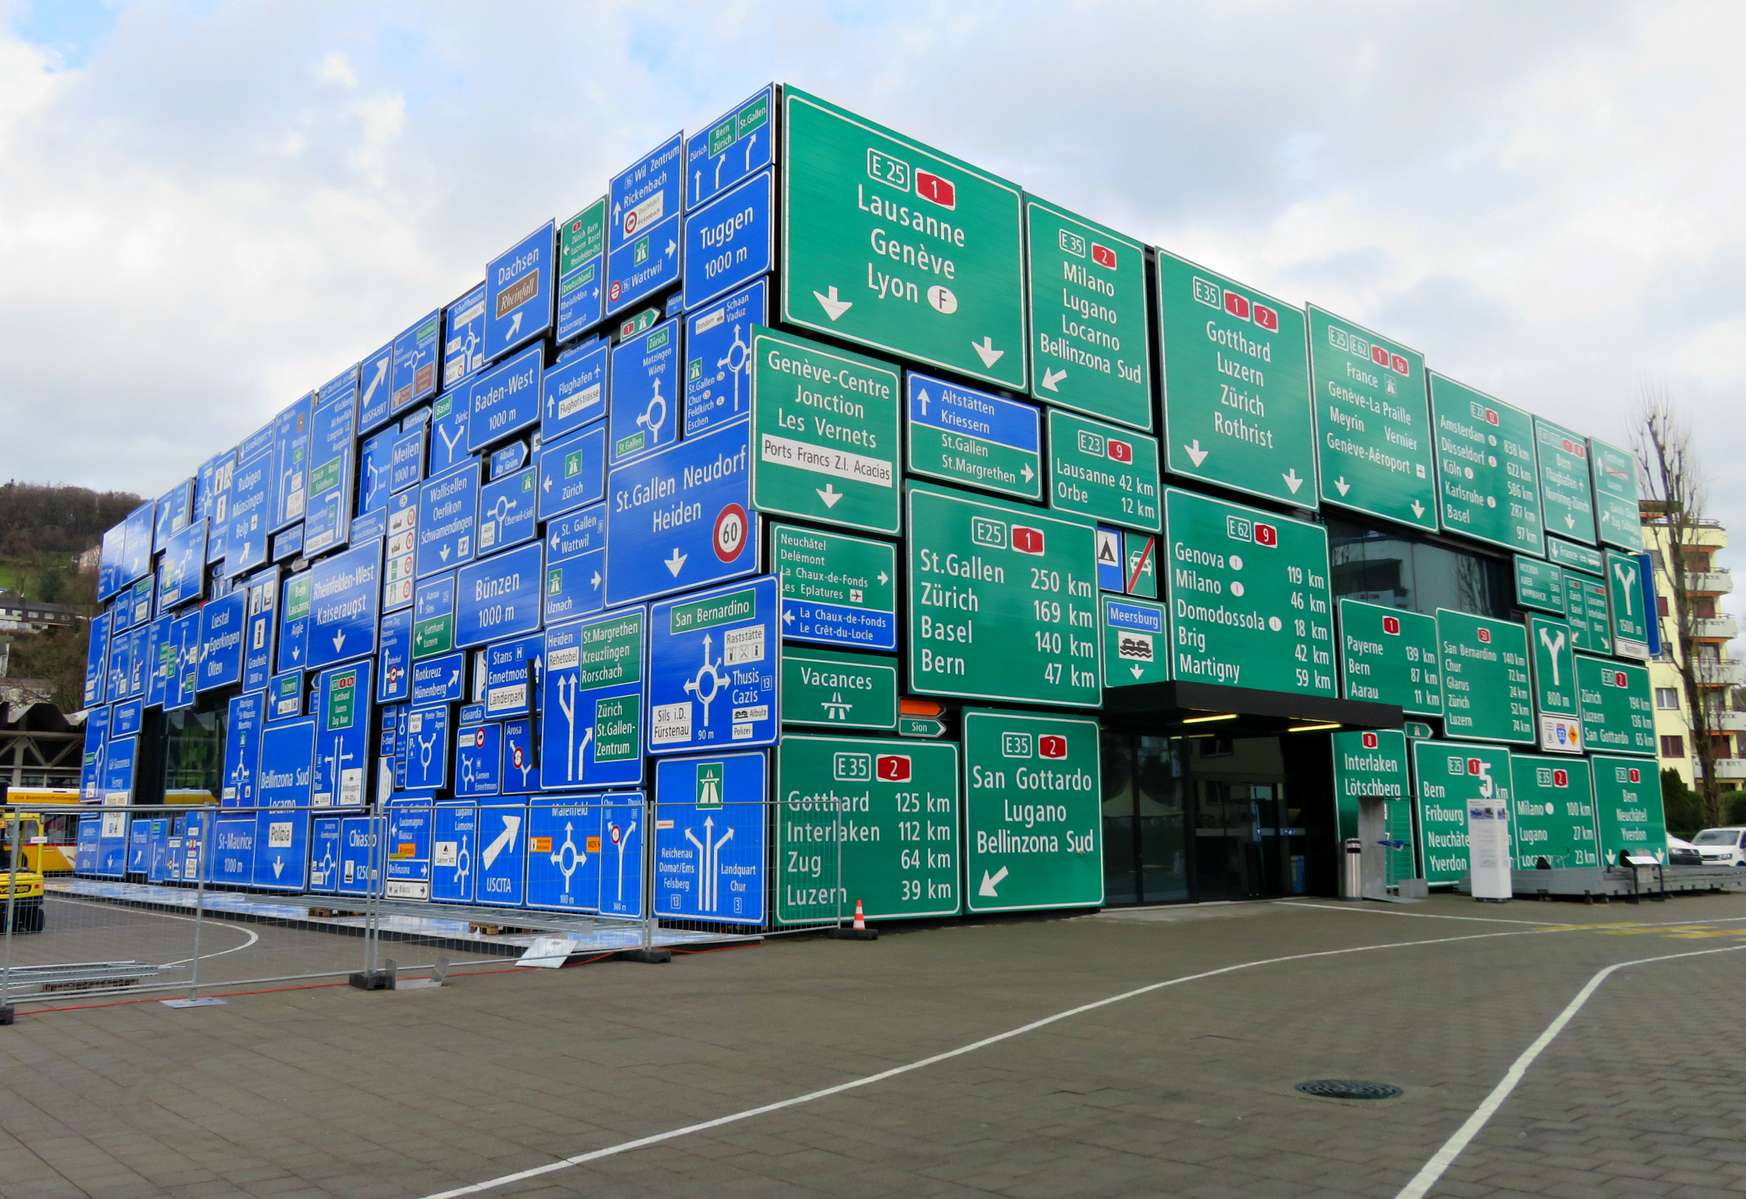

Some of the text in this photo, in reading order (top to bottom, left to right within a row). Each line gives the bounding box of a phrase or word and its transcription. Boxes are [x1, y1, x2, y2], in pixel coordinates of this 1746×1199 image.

[714, 135, 732, 152] Zürich
[624, 171, 666, 208] Rickenbach
[858, 183, 965, 248] Lausanne
[700, 207, 753, 248] Tuggen
[705, 246, 747, 279] 1000 m
[871, 229, 955, 279] Genève
[498, 248, 538, 285] Dachsen
[632, 260, 662, 287] Wattwil
[1063, 261, 1115, 297] Milano
[726, 295, 749, 311] Schaan
[1063, 288, 1117, 325] Lugano
[726, 308, 746, 322] Vaduz
[1062, 315, 1120, 351] Locarno
[1207, 321, 1271, 362] Gotthard
[1041, 334, 1142, 384] Bellinzona Sud
[1217, 352, 1264, 386] Luzern
[559, 371, 593, 396] Flughafen
[768, 351, 890, 400] Genève-Centre
[1347, 362, 1378, 388] France
[475, 368, 533, 413] Baden-West
[1220, 384, 1264, 417] Zürich
[688, 399, 714, 417] Feldkirch
[796, 386, 864, 419] Jonction
[942, 390, 995, 416] Altstätten
[489, 408, 516, 430] 1000 m
[688, 416, 708, 430] Eschen
[778, 408, 876, 448] Les Vernets
[941, 410, 990, 434] Kriessern
[1330, 406, 1416, 450] Meyrin Vernier
[1440, 415, 1485, 444] Amsterdam
[1215, 412, 1272, 448] Rothrist
[394, 441, 419, 461] Meilen
[1327, 433, 1410, 473] Genève-Aéroport
[617, 445, 746, 512] St.Gallen Neudorf
[1057, 458, 1153, 496] Lausanne 42 km
[431, 477, 467, 502] Wallisellen
[562, 484, 583, 499] Zürich
[1058, 480, 1088, 503] Orbe
[433, 500, 461, 520] Oerlikon
[653, 501, 701, 532] Heiden
[1121, 497, 1154, 519] 12 km
[1447, 504, 1469, 523] Basel
[422, 516, 472, 544] Schwamendingen
[723, 522, 737, 543] 60
[561, 535, 589, 553] Wattwil
[781, 534, 826, 551] Neuchâtel
[781, 550, 824, 566] Delémont
[1176, 542, 1224, 568] Genova
[921, 549, 1004, 584] St.Gallen
[475, 573, 520, 601] Bünzen
[1031, 568, 1091, 598] 250 km
[1176, 569, 1221, 593] Milano
[547, 599, 572, 614] Uznach
[921, 583, 978, 612] Zürich
[1291, 592, 1325, 613] 46 km
[212, 608, 230, 629] Liestal
[318, 594, 366, 625] Kaiseraugst
[480, 605, 514, 627] 1000 m
[676, 600, 749, 627] San Bernardino
[1035, 600, 1093, 629] 169 km
[1111, 608, 1158, 629] Meersburg
[1178, 599, 1264, 630] Domodossola
[549, 633, 572, 647] Heiden
[584, 622, 637, 644] St.Margrethen
[727, 629, 762, 644] Raststätte
[921, 615, 972, 644] Basel
[1179, 626, 1205, 651] Brig
[210, 631, 240, 655] Egerkingen
[1036, 631, 1093, 658] 140 km
[1348, 636, 1383, 655] Payerne
[583, 646, 629, 664] Kreuzlingen
[921, 649, 964, 675] Bern
[208, 661, 222, 676] Olten
[414, 666, 442, 680] Rotkreuz
[489, 668, 527, 685] Ennetmoos
[582, 667, 622, 683] Rorschach
[733, 667, 759, 686] Thusis
[1045, 664, 1095, 688] 47 km
[1180, 654, 1240, 682] Martigny
[1349, 658, 1370, 676] Bern
[1411, 669, 1437, 685] 87 km
[1445, 661, 1461, 672] Chur
[801, 667, 872, 690] Vacances
[1447, 677, 1469, 691] Glarus
[414, 683, 446, 698] Hünenberg
[490, 691, 523, 705] Länderpark
[733, 688, 758, 705] Cazis
[1351, 682, 1378, 699] Aarau
[1415, 690, 1439, 705] 11 km
[598, 702, 622, 718] Zürich
[1448, 695, 1470, 708] Zürich
[463, 709, 481, 720] Guarda
[1450, 712, 1472, 726] Luzern
[507, 725, 522, 735] Arosa
[598, 723, 635, 736] St.Gallen-
[655, 725, 689, 738] Fürstenau
[912, 722, 927, 732] Sion
[597, 743, 629, 756] Zentrum
[1345, 753, 1397, 772] Interlaken
[262, 767, 308, 789] Bellinzona Sud
[973, 766, 1091, 791] San Gottardo
[1345, 778, 1400, 800] Lötschberg
[1424, 781, 1445, 797] Bern
[788, 790, 869, 812] Gotthard
[895, 792, 950, 812] 125 km
[1518, 801, 1544, 815] Milano
[1005, 800, 1066, 828] Lugano
[1425, 805, 1463, 825] Fribourg
[219, 833, 252, 850] St-Maurice
[788, 822, 880, 842] Interlaken
[898, 821, 950, 841] 112 km
[977, 830, 1094, 853] Bellinzona Sud
[1520, 827, 1547, 845] Lugano
[662, 848, 692, 859] Reichenau
[901, 849, 950, 869] 64 km
[1430, 856, 1466, 871] Yverdon
[659, 862, 694, 874] Domat/Ems
[721, 864, 756, 876] Landquart
[788, 852, 821, 877] Zug
[487, 878, 511, 892] USCITA
[664, 879, 689, 891] Felsberg
[731, 880, 746, 891] Chur
[788, 884, 847, 906] Luzern
[902, 879, 951, 900] 39 km
